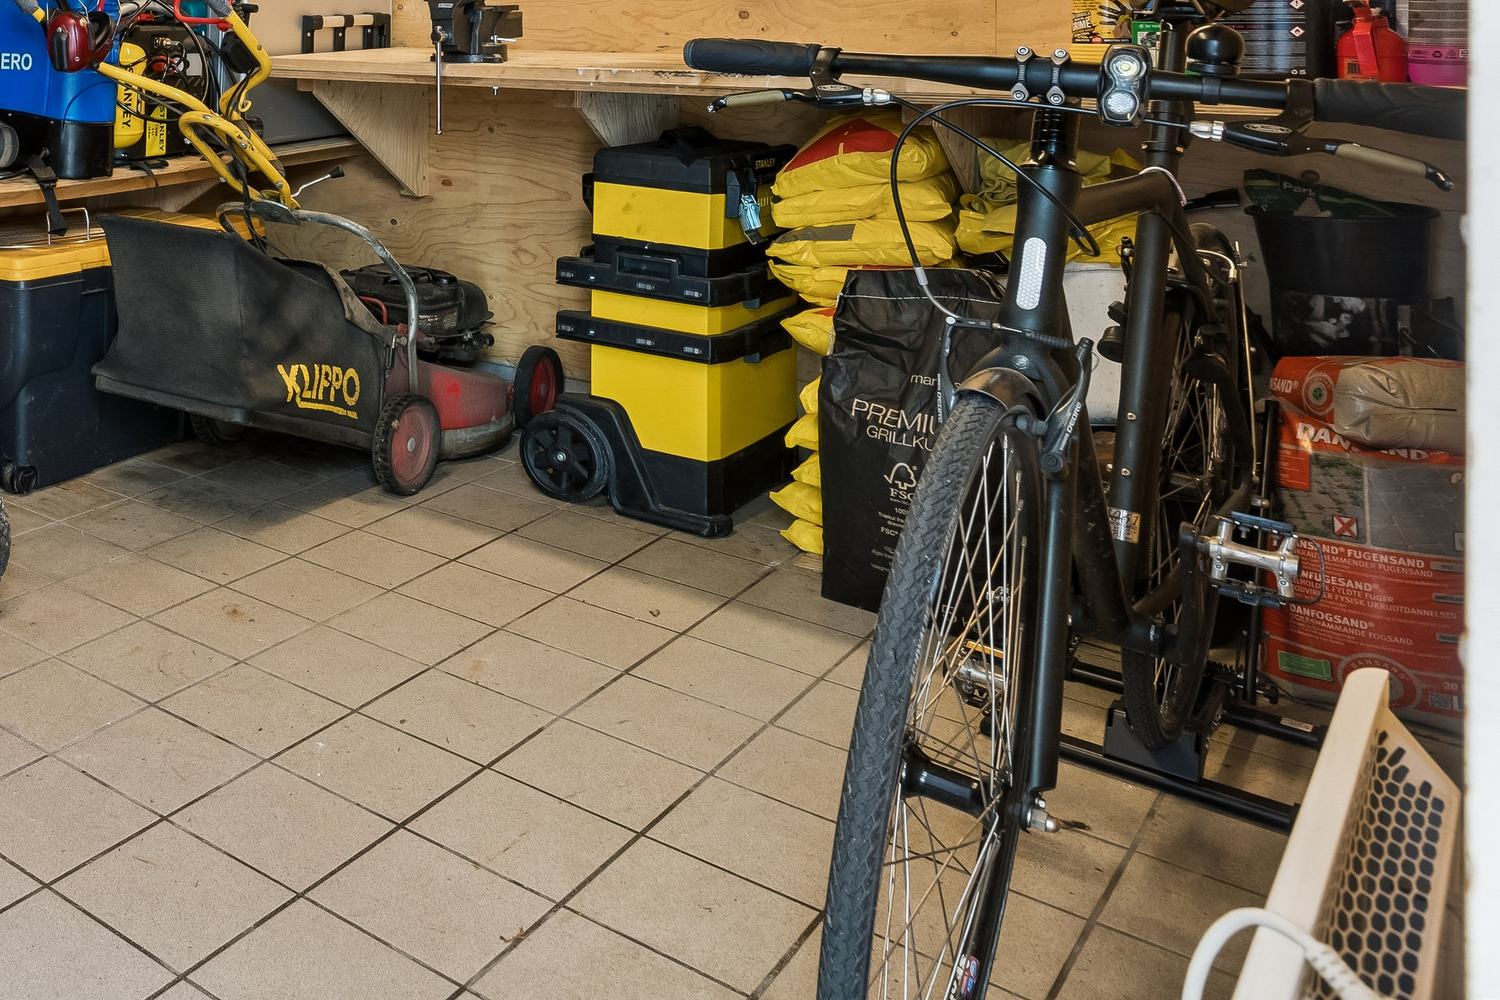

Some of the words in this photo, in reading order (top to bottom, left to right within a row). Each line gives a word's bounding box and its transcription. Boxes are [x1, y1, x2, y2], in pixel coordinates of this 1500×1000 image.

[122, 67, 134, 128] SANLEY
[277, 363, 360, 407] KLIPPO
[851, 398, 935, 436] PREMI
[1066, 401, 1083, 434] DEORE
[866, 425, 933, 452] GRILLKU
[894, 507, 908, 515] 100
[1347, 548, 1425, 569] FUGENSAND
[1378, 564, 1433, 578] FUGENSAND
[1332, 585, 1363, 597] FYLDTE
[1365, 592, 1394, 603] FUGER
[1335, 594, 1365, 606] FYSISK
[1368, 631, 1413, 646] FOGSAND
